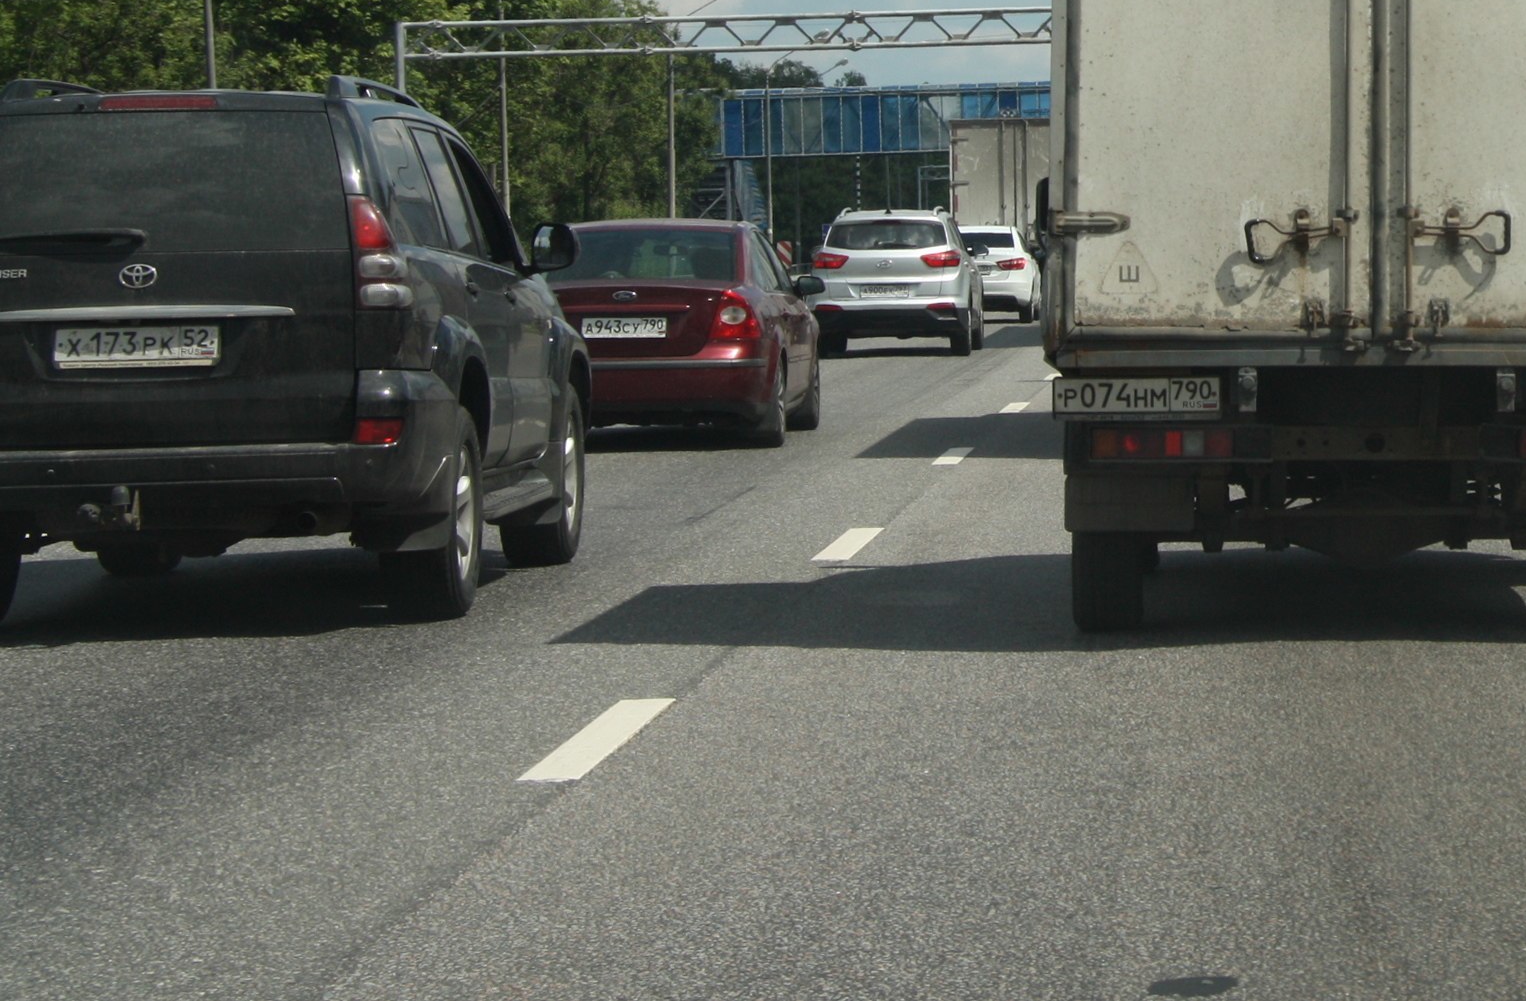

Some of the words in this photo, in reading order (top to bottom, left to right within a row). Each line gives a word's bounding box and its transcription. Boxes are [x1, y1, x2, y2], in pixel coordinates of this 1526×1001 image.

[1119, 265, 1140, 283] Ш
[642, 319, 664, 330] 790
[183, 329, 209, 348] 52
[1172, 380, 1212, 401] 790
[1182, 401, 1202, 409] RUS
